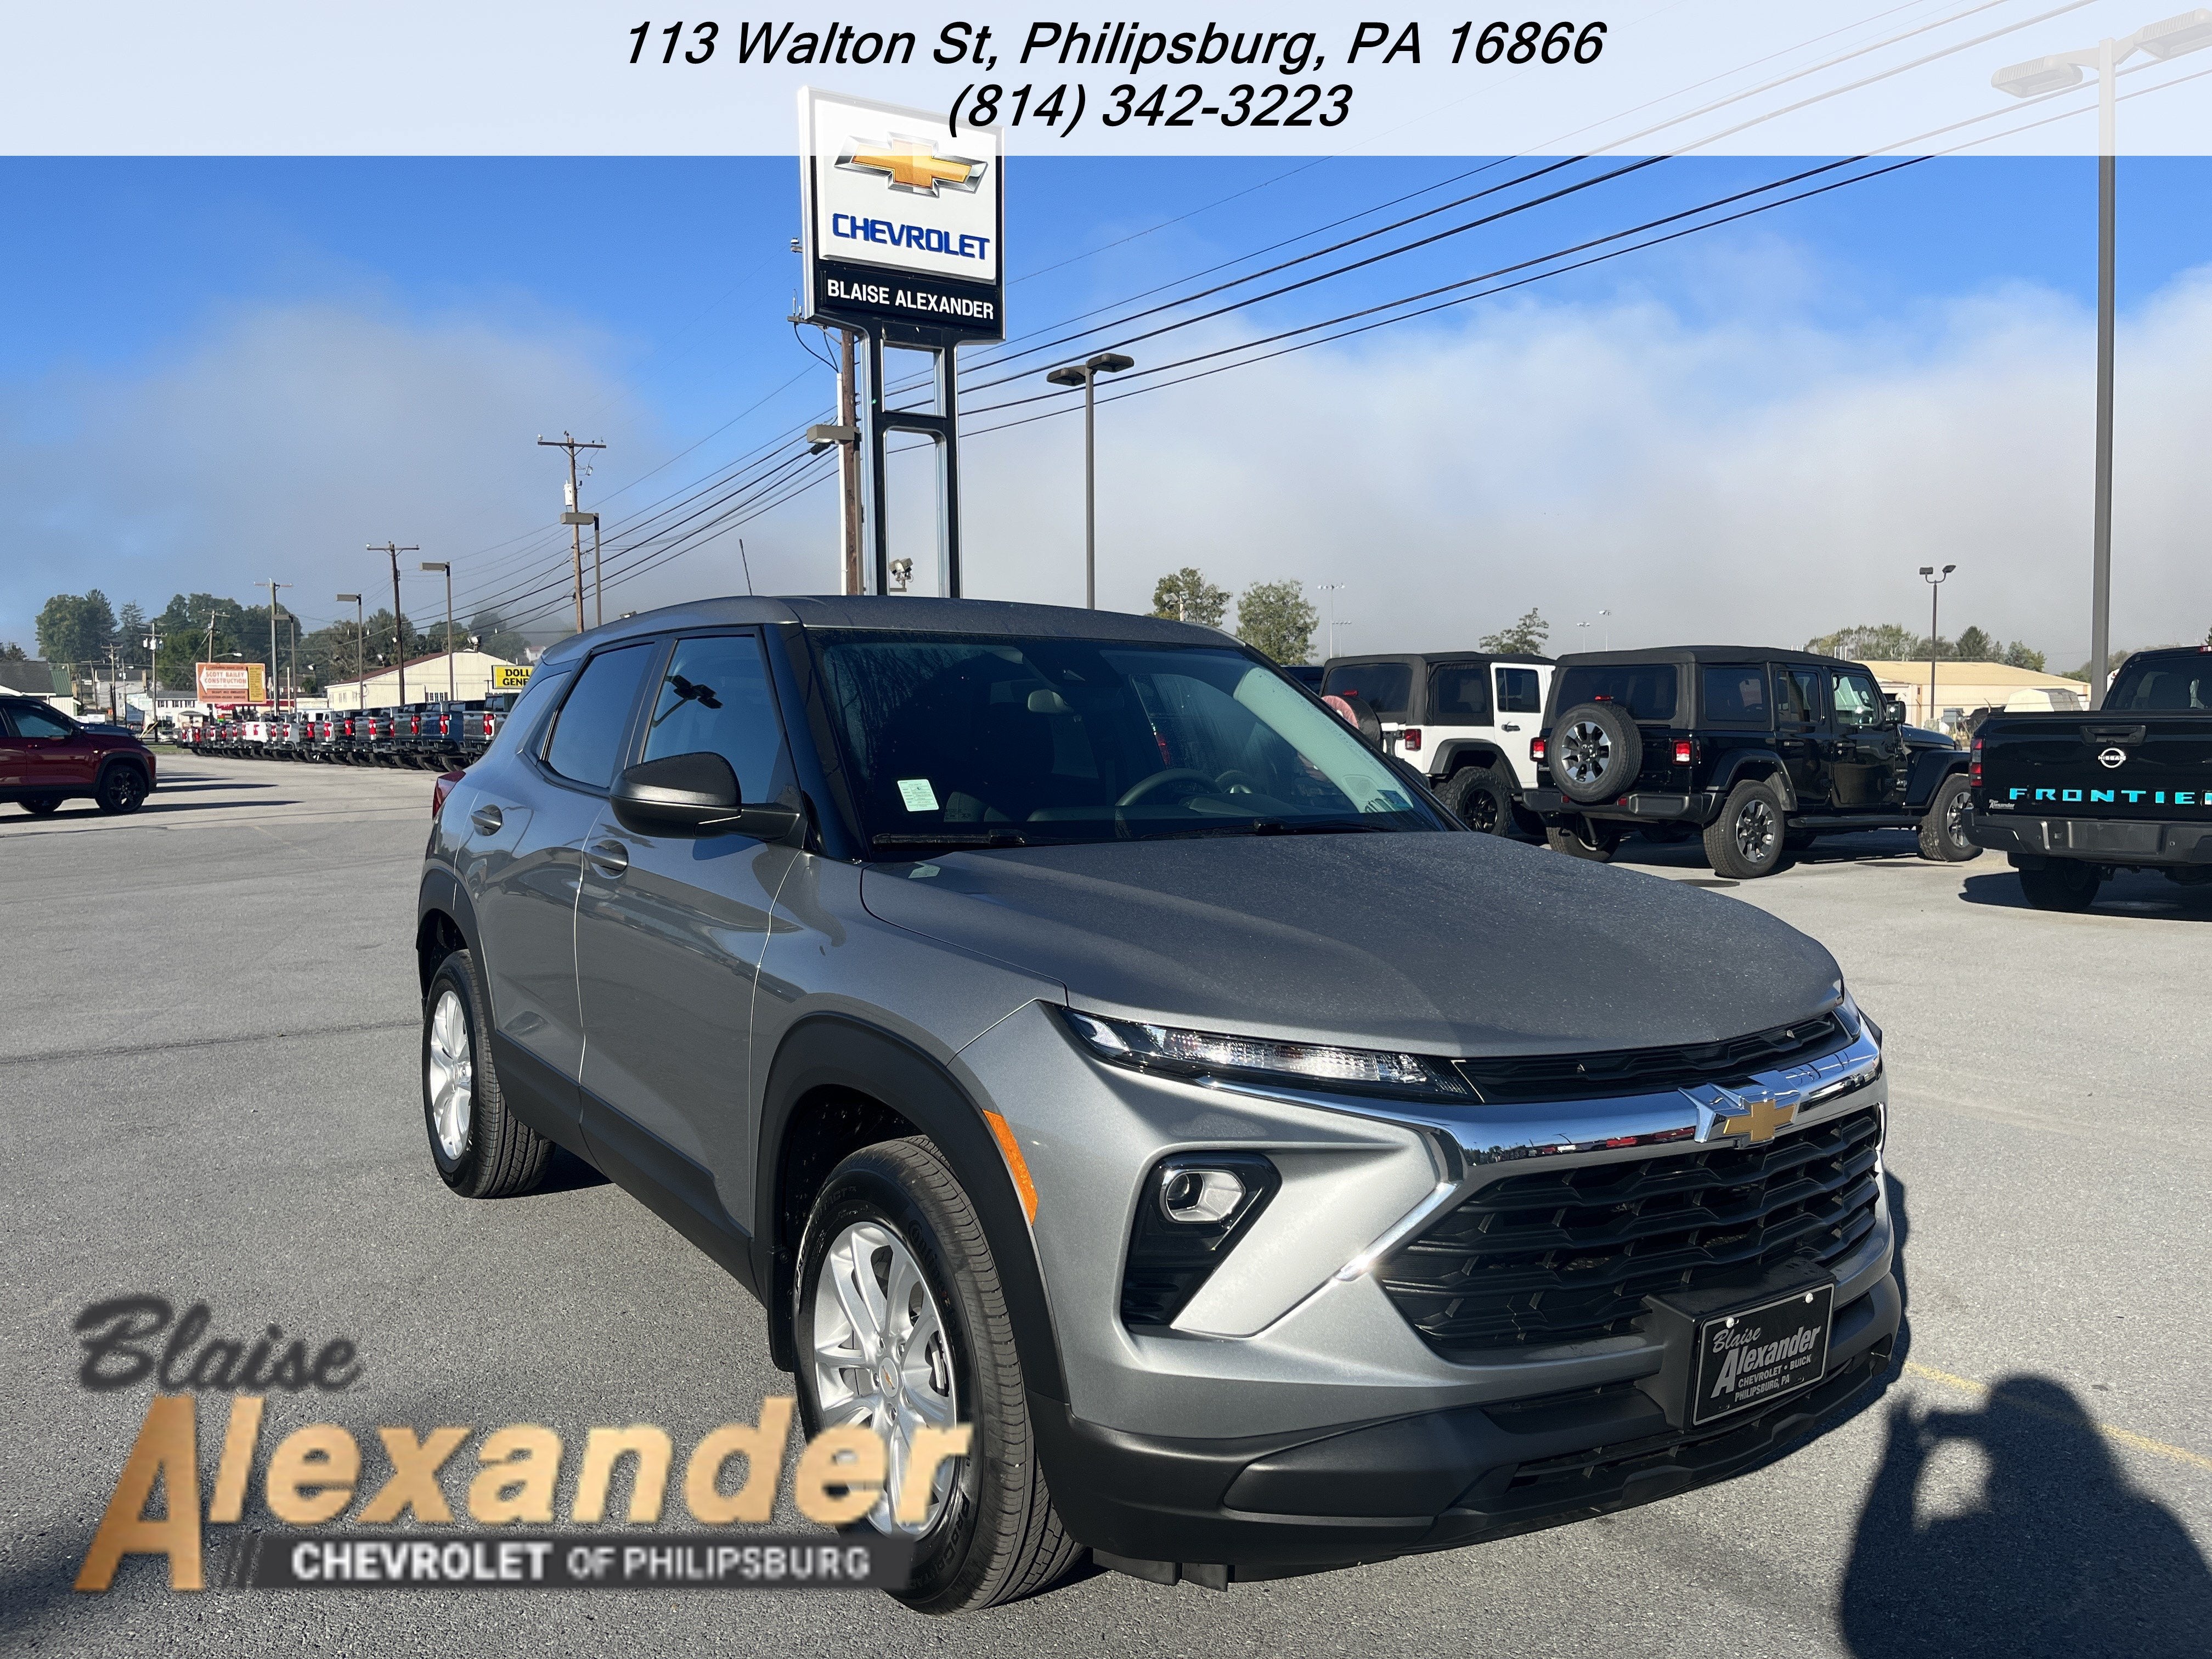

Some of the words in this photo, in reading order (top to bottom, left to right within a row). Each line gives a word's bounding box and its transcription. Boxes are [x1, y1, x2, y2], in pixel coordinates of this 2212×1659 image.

[832, 213, 990, 259] CHEVROLET
[827, 279, 890, 305] BLAISE
[895, 290, 994, 319] ALEXANDER
[1712, 1327, 1761, 1353] Blaise
[1710, 1326, 1821, 1398] Alexander
[1738, 1365, 1782, 1388] CHEVROLET
[1790, 1354, 1812, 1370] BUICK
[1734, 1381, 1780, 1402] PHILIPSBURG,
[1781, 1374, 1790, 1386] PA
